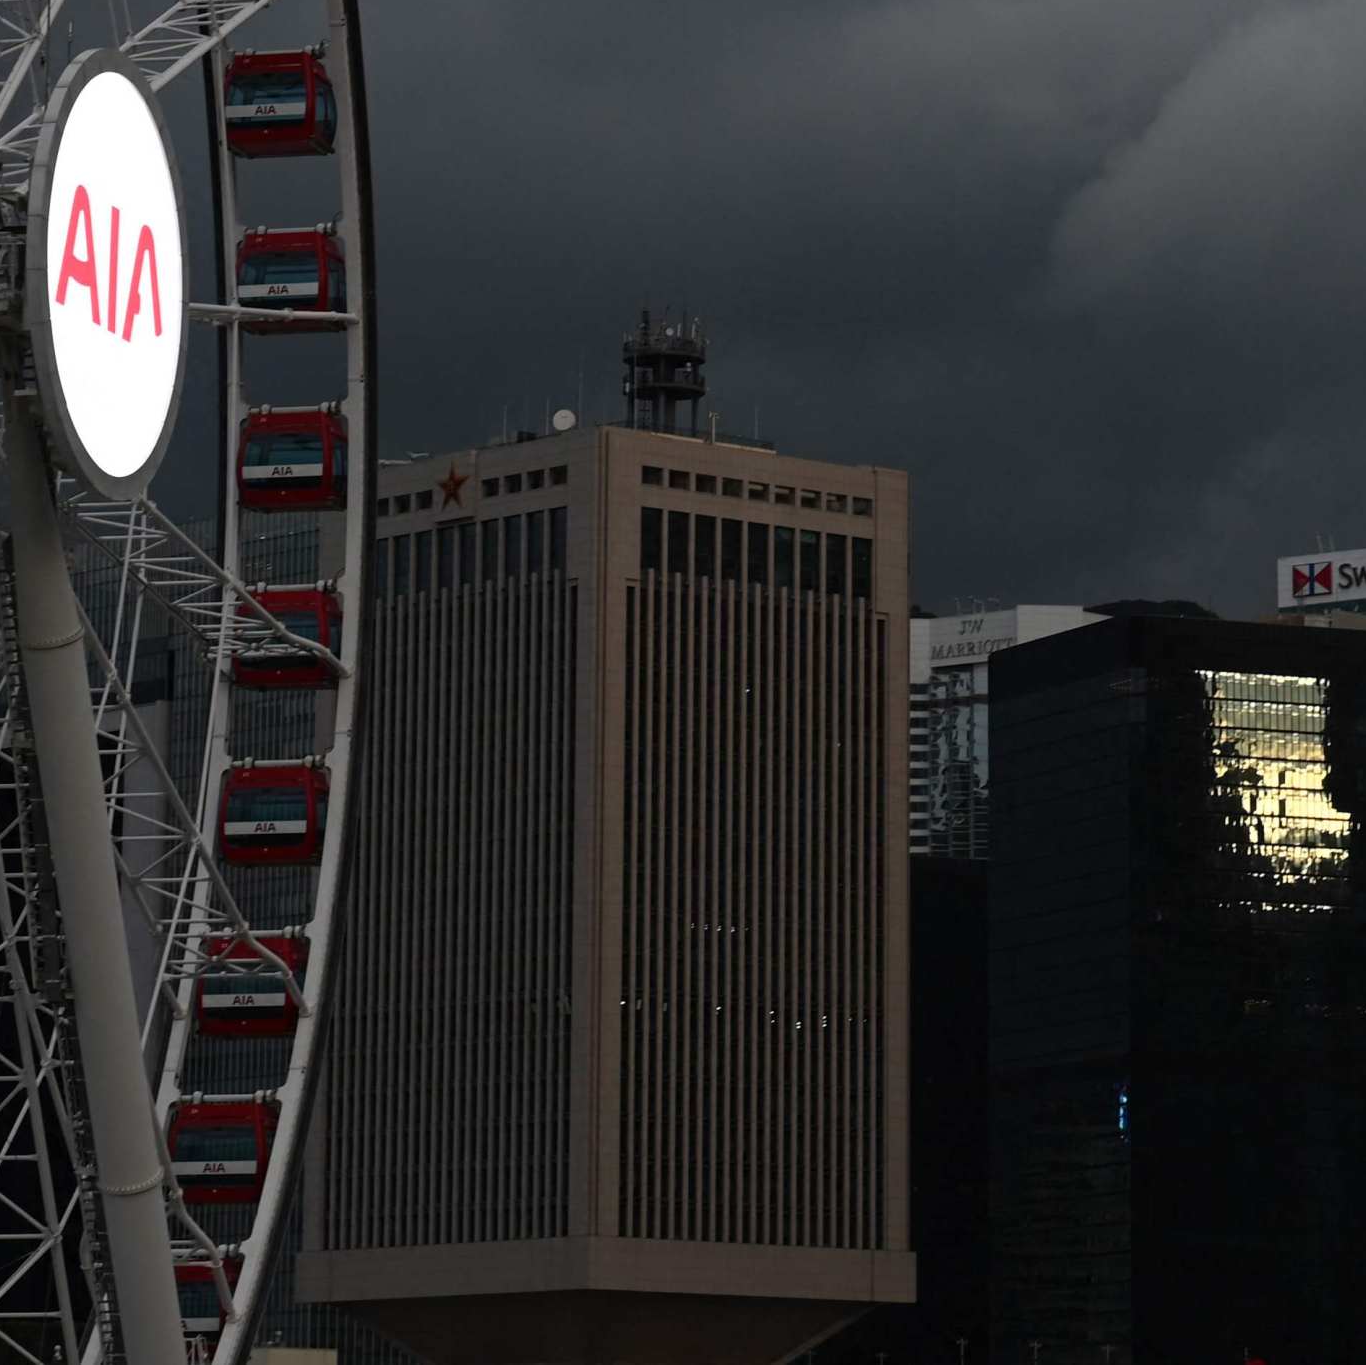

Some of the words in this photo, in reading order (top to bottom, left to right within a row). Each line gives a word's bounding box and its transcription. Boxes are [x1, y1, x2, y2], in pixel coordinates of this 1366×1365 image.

[254, 105, 276, 115] AIA
[56, 185, 162, 342] AIA
[268, 286, 288, 295] AIA
[272, 467, 293, 476] AIA
[931, 637, 1013, 659] MARRIOTT
[255, 823, 276, 832] AIA
[233, 996, 255, 1005] AIA
[203, 1163, 225, 1173] AIA
